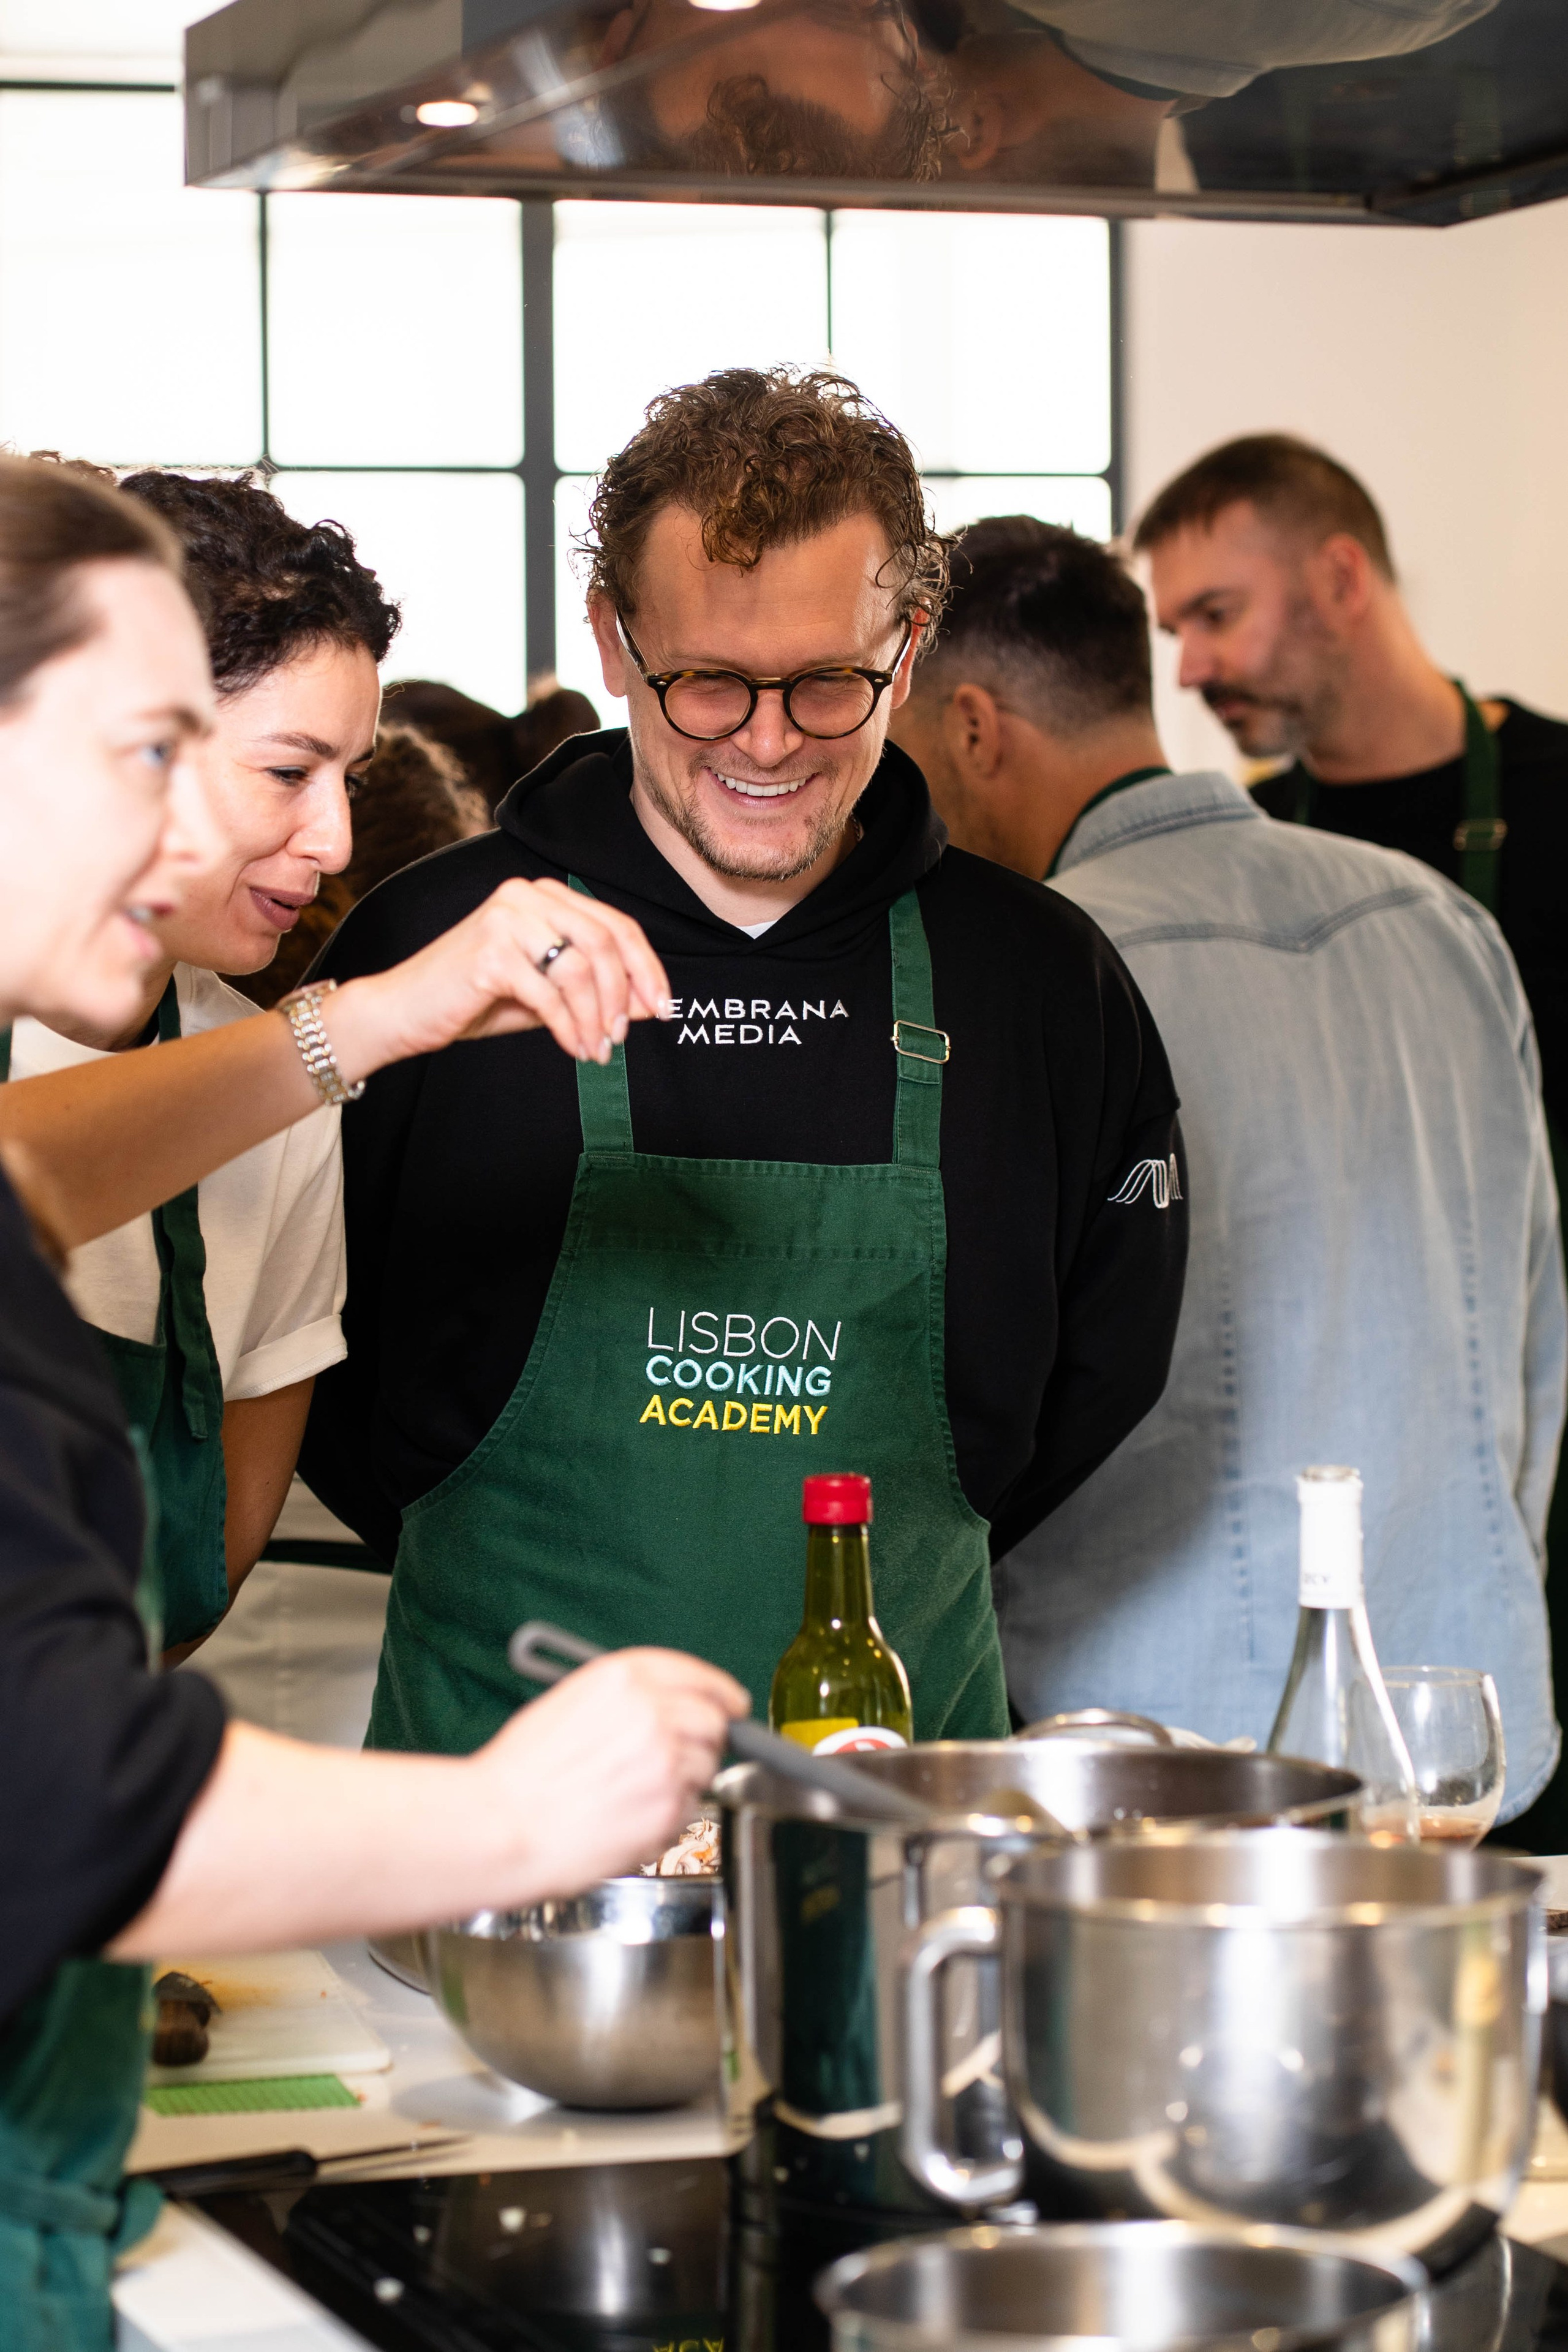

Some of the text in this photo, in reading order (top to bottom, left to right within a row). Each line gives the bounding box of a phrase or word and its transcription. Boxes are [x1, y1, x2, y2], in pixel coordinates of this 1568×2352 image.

[653, 998, 850, 1020] EMBRANA
[677, 1023, 802, 1045] MEDIA
[647, 1306, 842, 1361] LISBON
[646, 1355, 832, 1396] COOKING
[639, 1394, 829, 1435] ACADEMY
